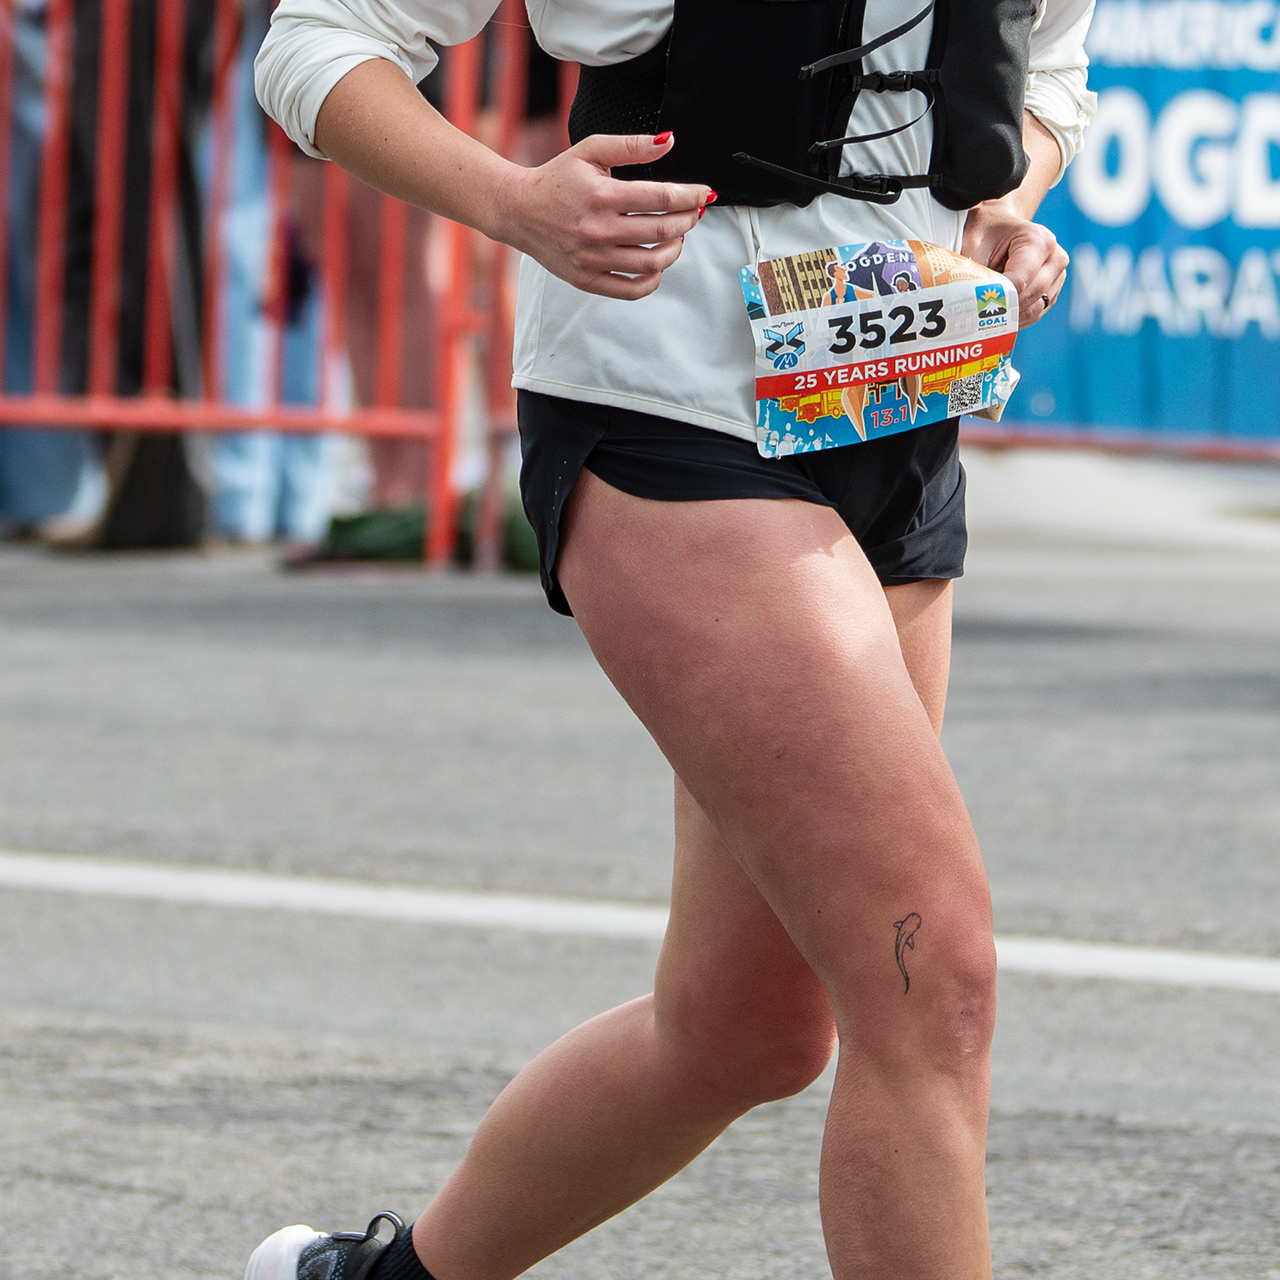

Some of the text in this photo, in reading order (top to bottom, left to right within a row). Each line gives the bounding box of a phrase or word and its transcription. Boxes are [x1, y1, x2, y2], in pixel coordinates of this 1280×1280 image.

[846, 252, 909, 272] OGDEN
[828, 299, 947, 355] 3523
[978, 316, 1008, 328] GOAL
[794, 344, 983, 391] 25 YEARS RUNNING
[871, 405, 907, 428] 13.1
